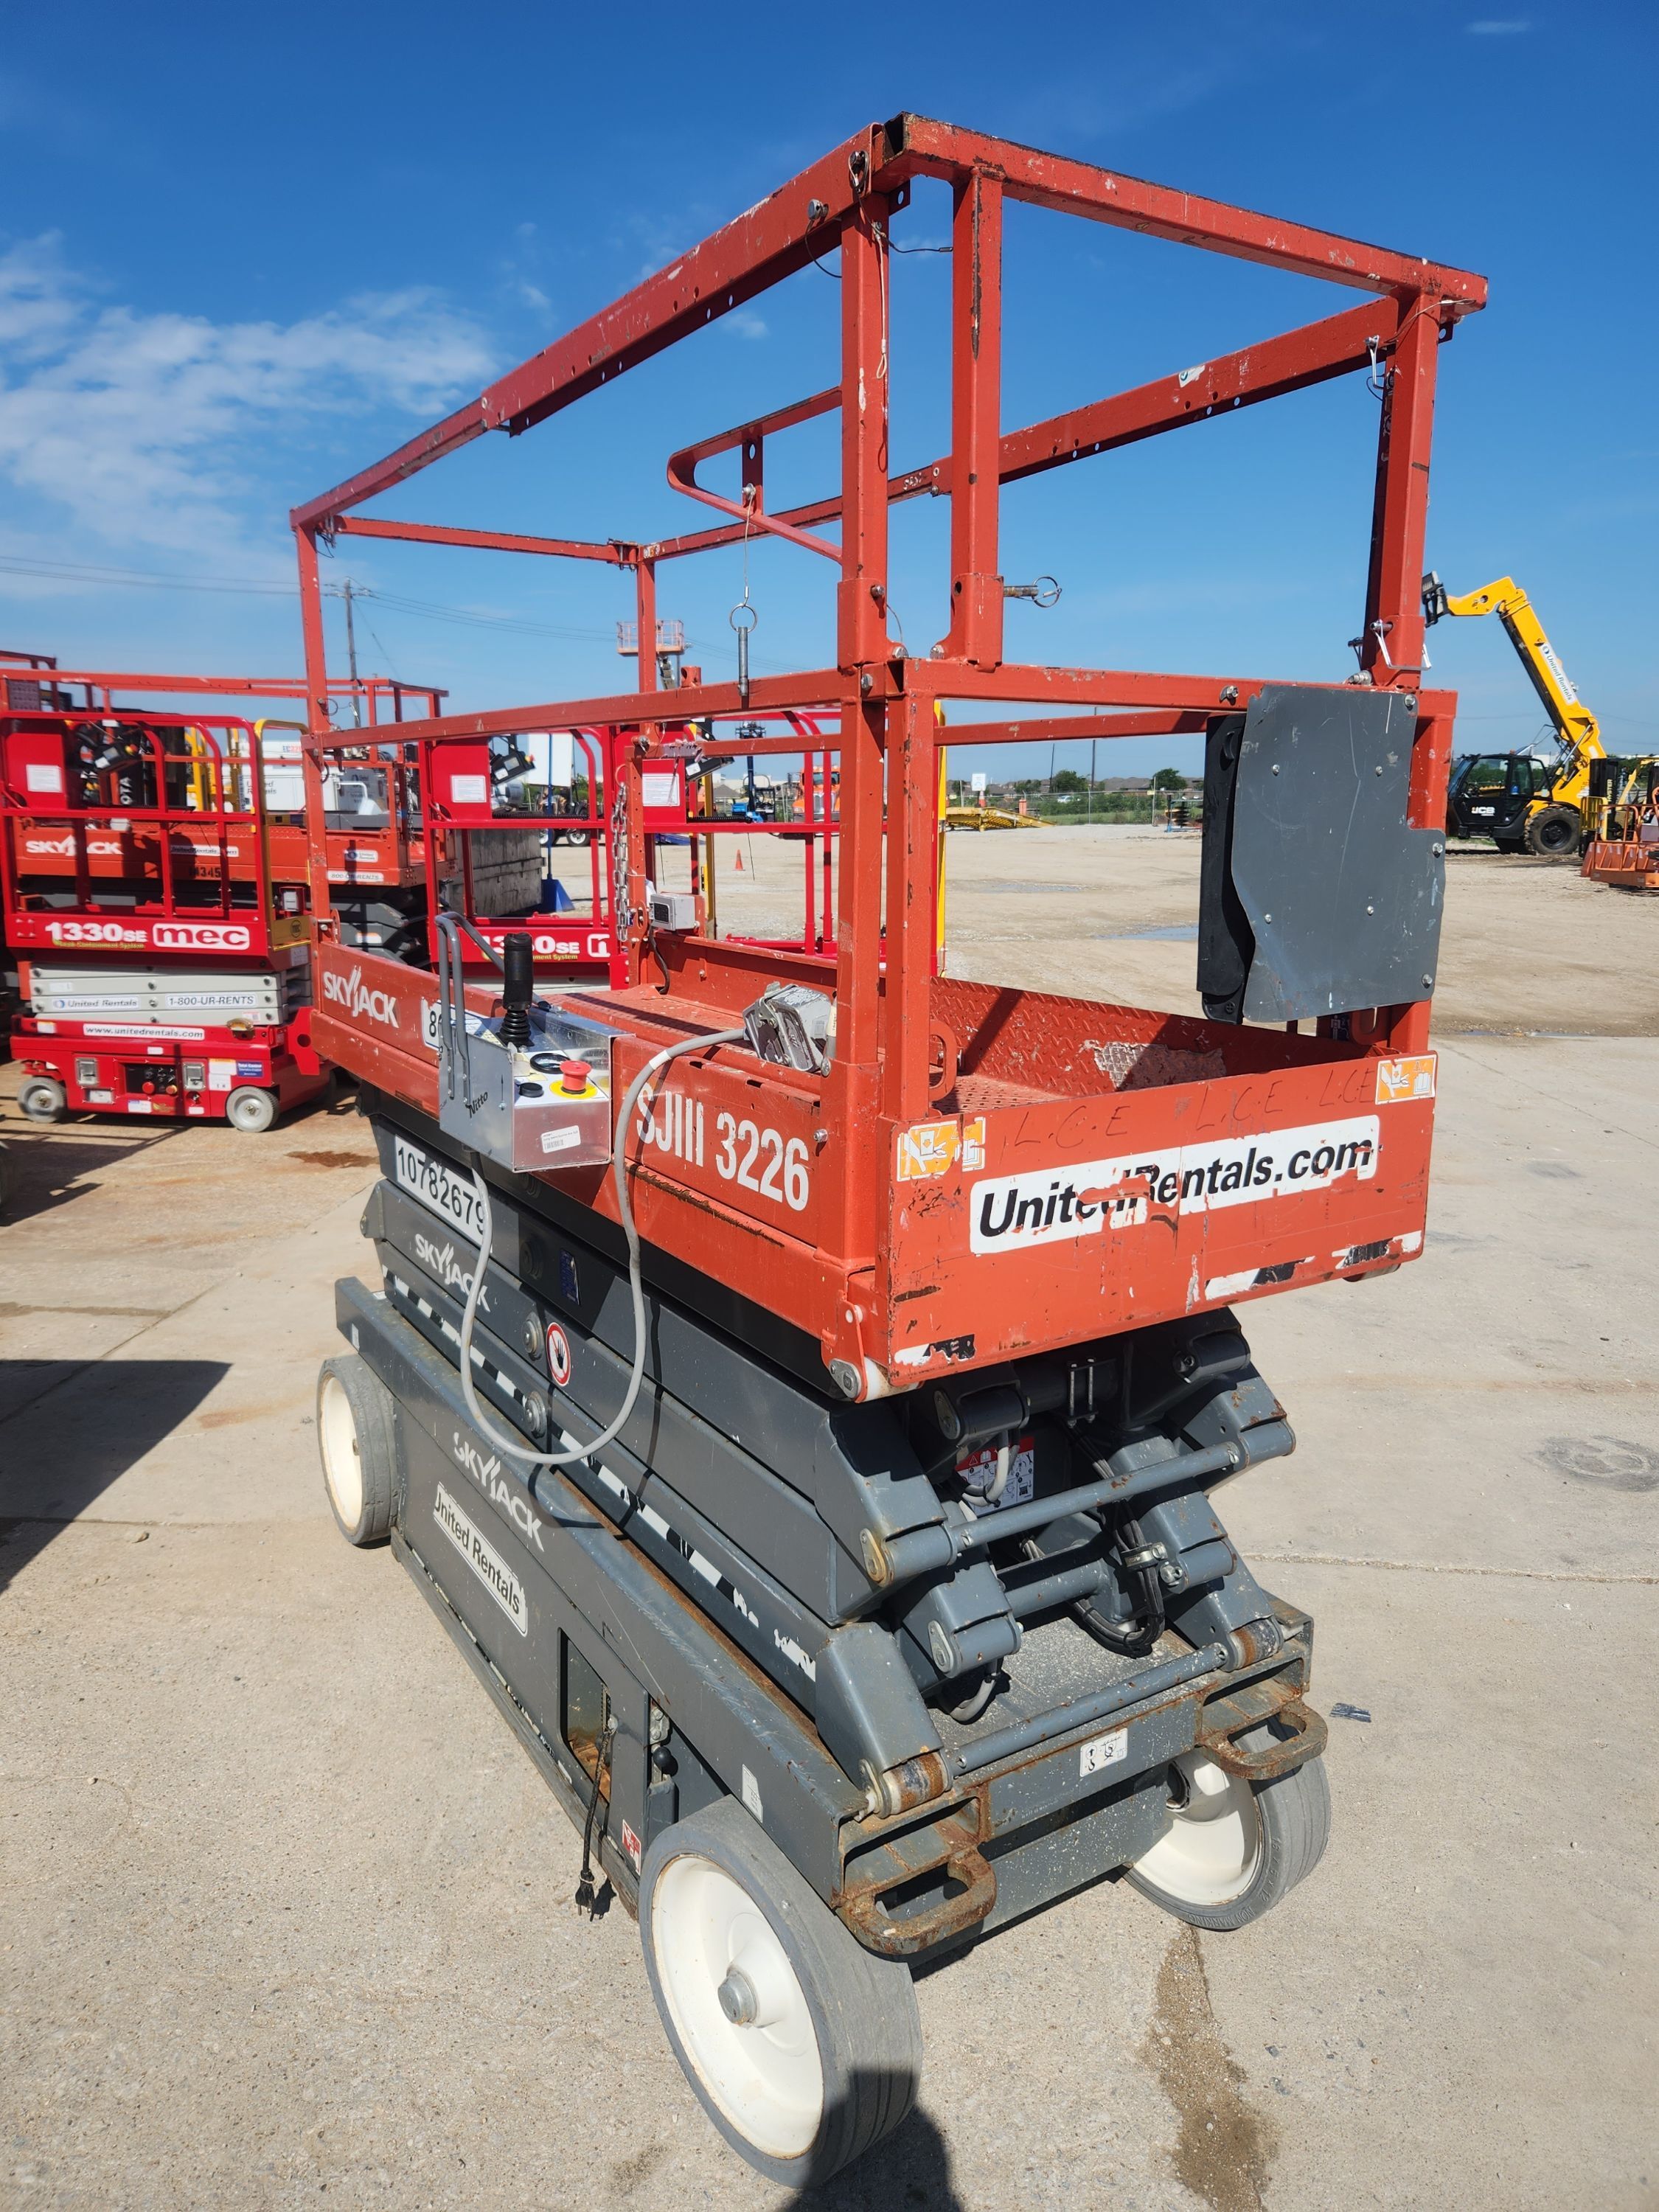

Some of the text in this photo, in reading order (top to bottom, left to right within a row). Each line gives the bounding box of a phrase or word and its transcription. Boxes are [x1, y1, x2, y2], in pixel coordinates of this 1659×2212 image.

[26, 835, 124, 856] SKYJCK
[45, 922, 248, 946] 1330SE mec
[68, 998, 137, 1008] United Rentals
[168, 995, 254, 1006] 1-800-UR-RENTS
[323, 964, 400, 1029] SKYJACK
[86, 1026, 204, 1038] www.unitedrentals.com
[465, 1091, 488, 1119] Nitto
[716, 1112, 809, 1211] 3226
[398, 1147, 484, 1236] 10782679
[414, 1234, 491, 1313] SKYJACK
[453, 1432, 545, 1552] SKYJACK
[473, 1535, 521, 1615] Rentals
